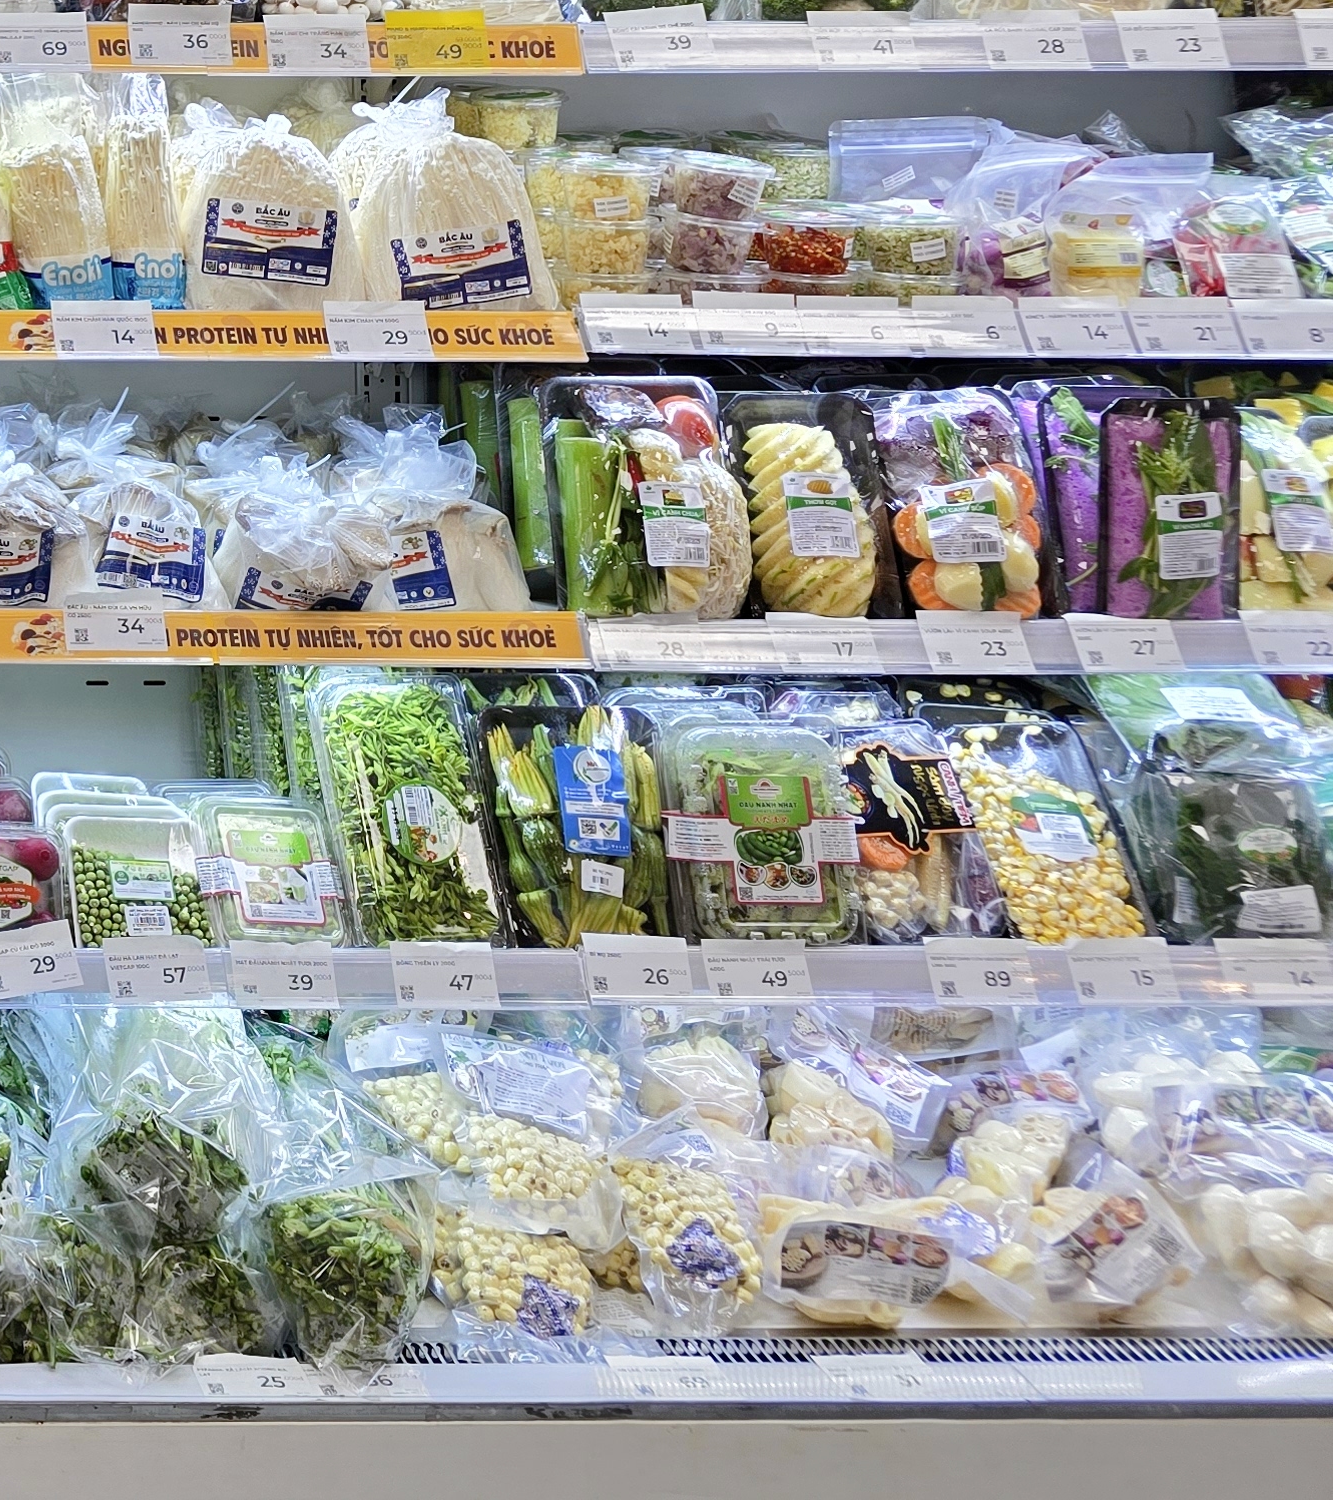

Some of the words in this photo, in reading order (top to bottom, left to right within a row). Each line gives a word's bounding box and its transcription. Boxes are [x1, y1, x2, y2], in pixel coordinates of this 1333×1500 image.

[183, 34, 208, 48] 36
[1038, 39, 1064, 53] 28
[41, 256, 101, 287] Enoki
[383, 331, 407, 344] 29
[176, 627, 261, 650] PROTEIN
[264, 627, 294, 652] TỰ
[297, 624, 363, 653] NHIÊN,
[366, 624, 405, 649] TỐT
[409, 629, 454, 649] CHO
[457, 626, 499, 649] SỨC
[501, 624, 558, 649] KHOẺ
[981, 642, 1006, 656] 23
[164, 967, 185, 983] 57
[762, 971, 787, 986] 49
